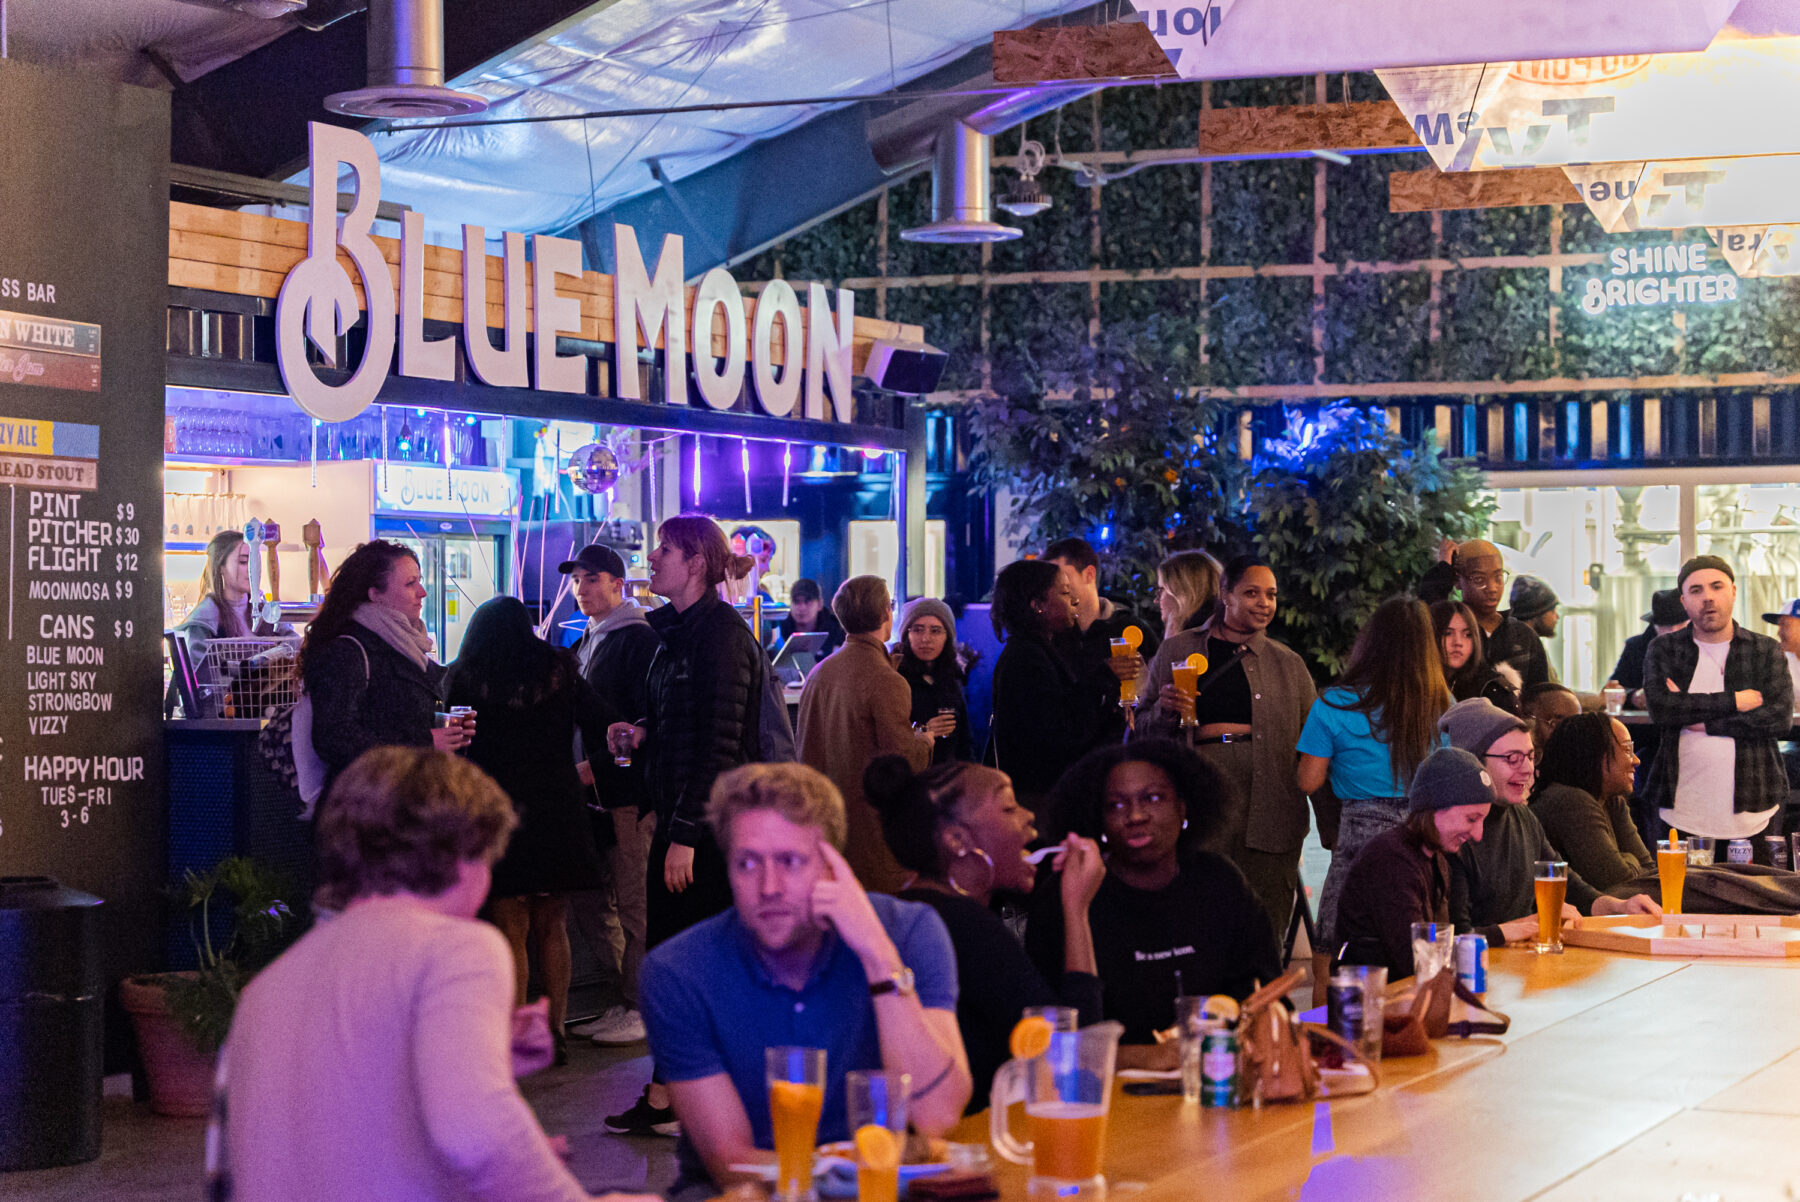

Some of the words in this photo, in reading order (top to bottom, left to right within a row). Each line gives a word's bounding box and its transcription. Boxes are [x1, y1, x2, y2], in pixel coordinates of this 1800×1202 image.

[276, 120, 587, 422] BLUE
[613, 223, 855, 424] MOON
[1609, 243, 1708, 276] SHINE
[27, 282, 56, 304] BAR
[1581, 273, 1738, 315] BRIGHTER
[15, 320, 75, 348] WHITE
[17, 425, 38, 448] ALE
[0, 462, 34, 478] EAD
[37, 465, 84, 482] STOUT
[401, 468, 443, 506] BLUE
[29, 491, 81, 518] PINT
[116, 502, 135, 522] $9
[28, 518, 113, 547] PITCHER
[115, 526, 140, 546] $30
[28, 546, 103, 572] FLIGHT
[115, 552, 138, 573] $12
[28, 581, 110, 601] MOONMOSA
[115, 580, 133, 600] $9
[39, 614, 95, 640] CANS
[114, 620, 134, 639] $9
[26, 645, 61, 666] BLUE
[66, 646, 104, 666] MOON
[27, 671, 66, 691] LIGHT
[70, 671, 97, 690] SKY
[28, 692, 113, 712] STRONGBOW
[28, 715, 69, 736] VIZZY
[24, 755, 90, 783] HAPPY
[93, 756, 144, 782] HOUR
[1729, 847, 1752, 855] VIZZY
